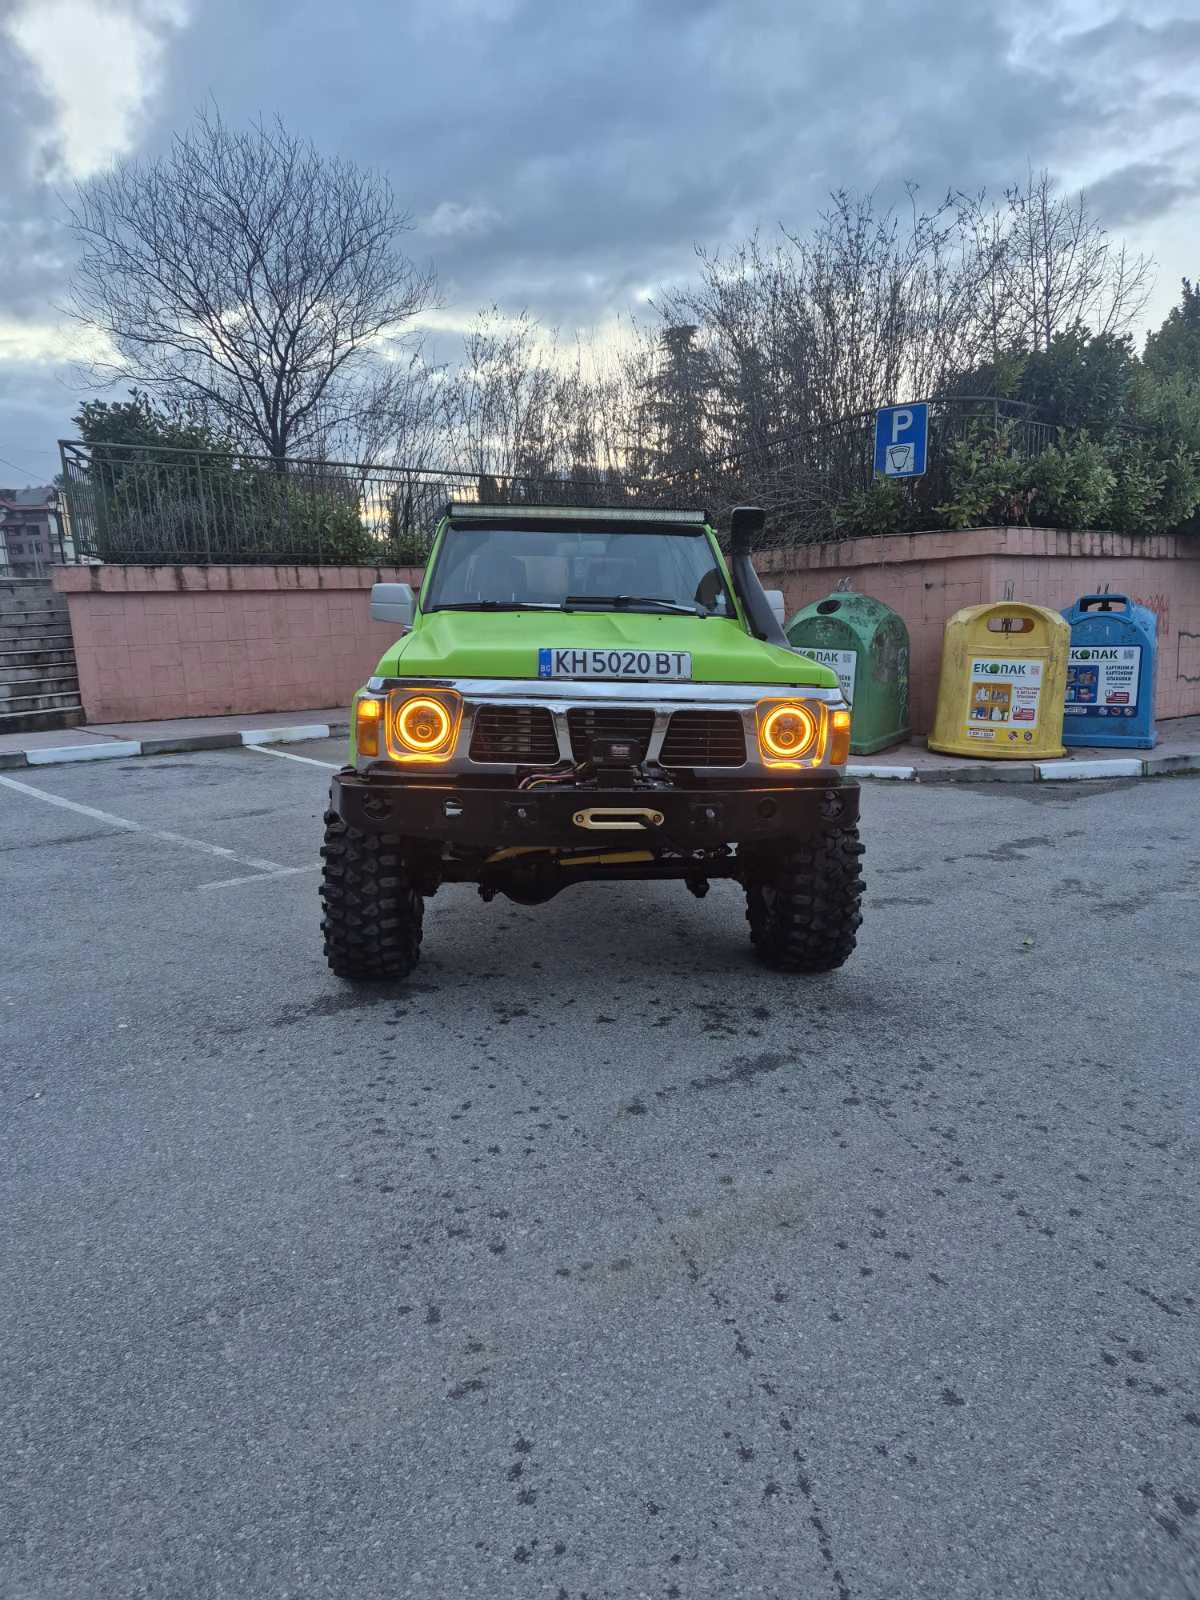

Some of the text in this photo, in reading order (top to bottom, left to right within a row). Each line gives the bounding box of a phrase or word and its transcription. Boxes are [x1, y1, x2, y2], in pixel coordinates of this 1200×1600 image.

[892, 409, 913, 442] P
[555, 651, 686, 675] KH 5020 BT
[1071, 649, 1118, 660] КОПАК
